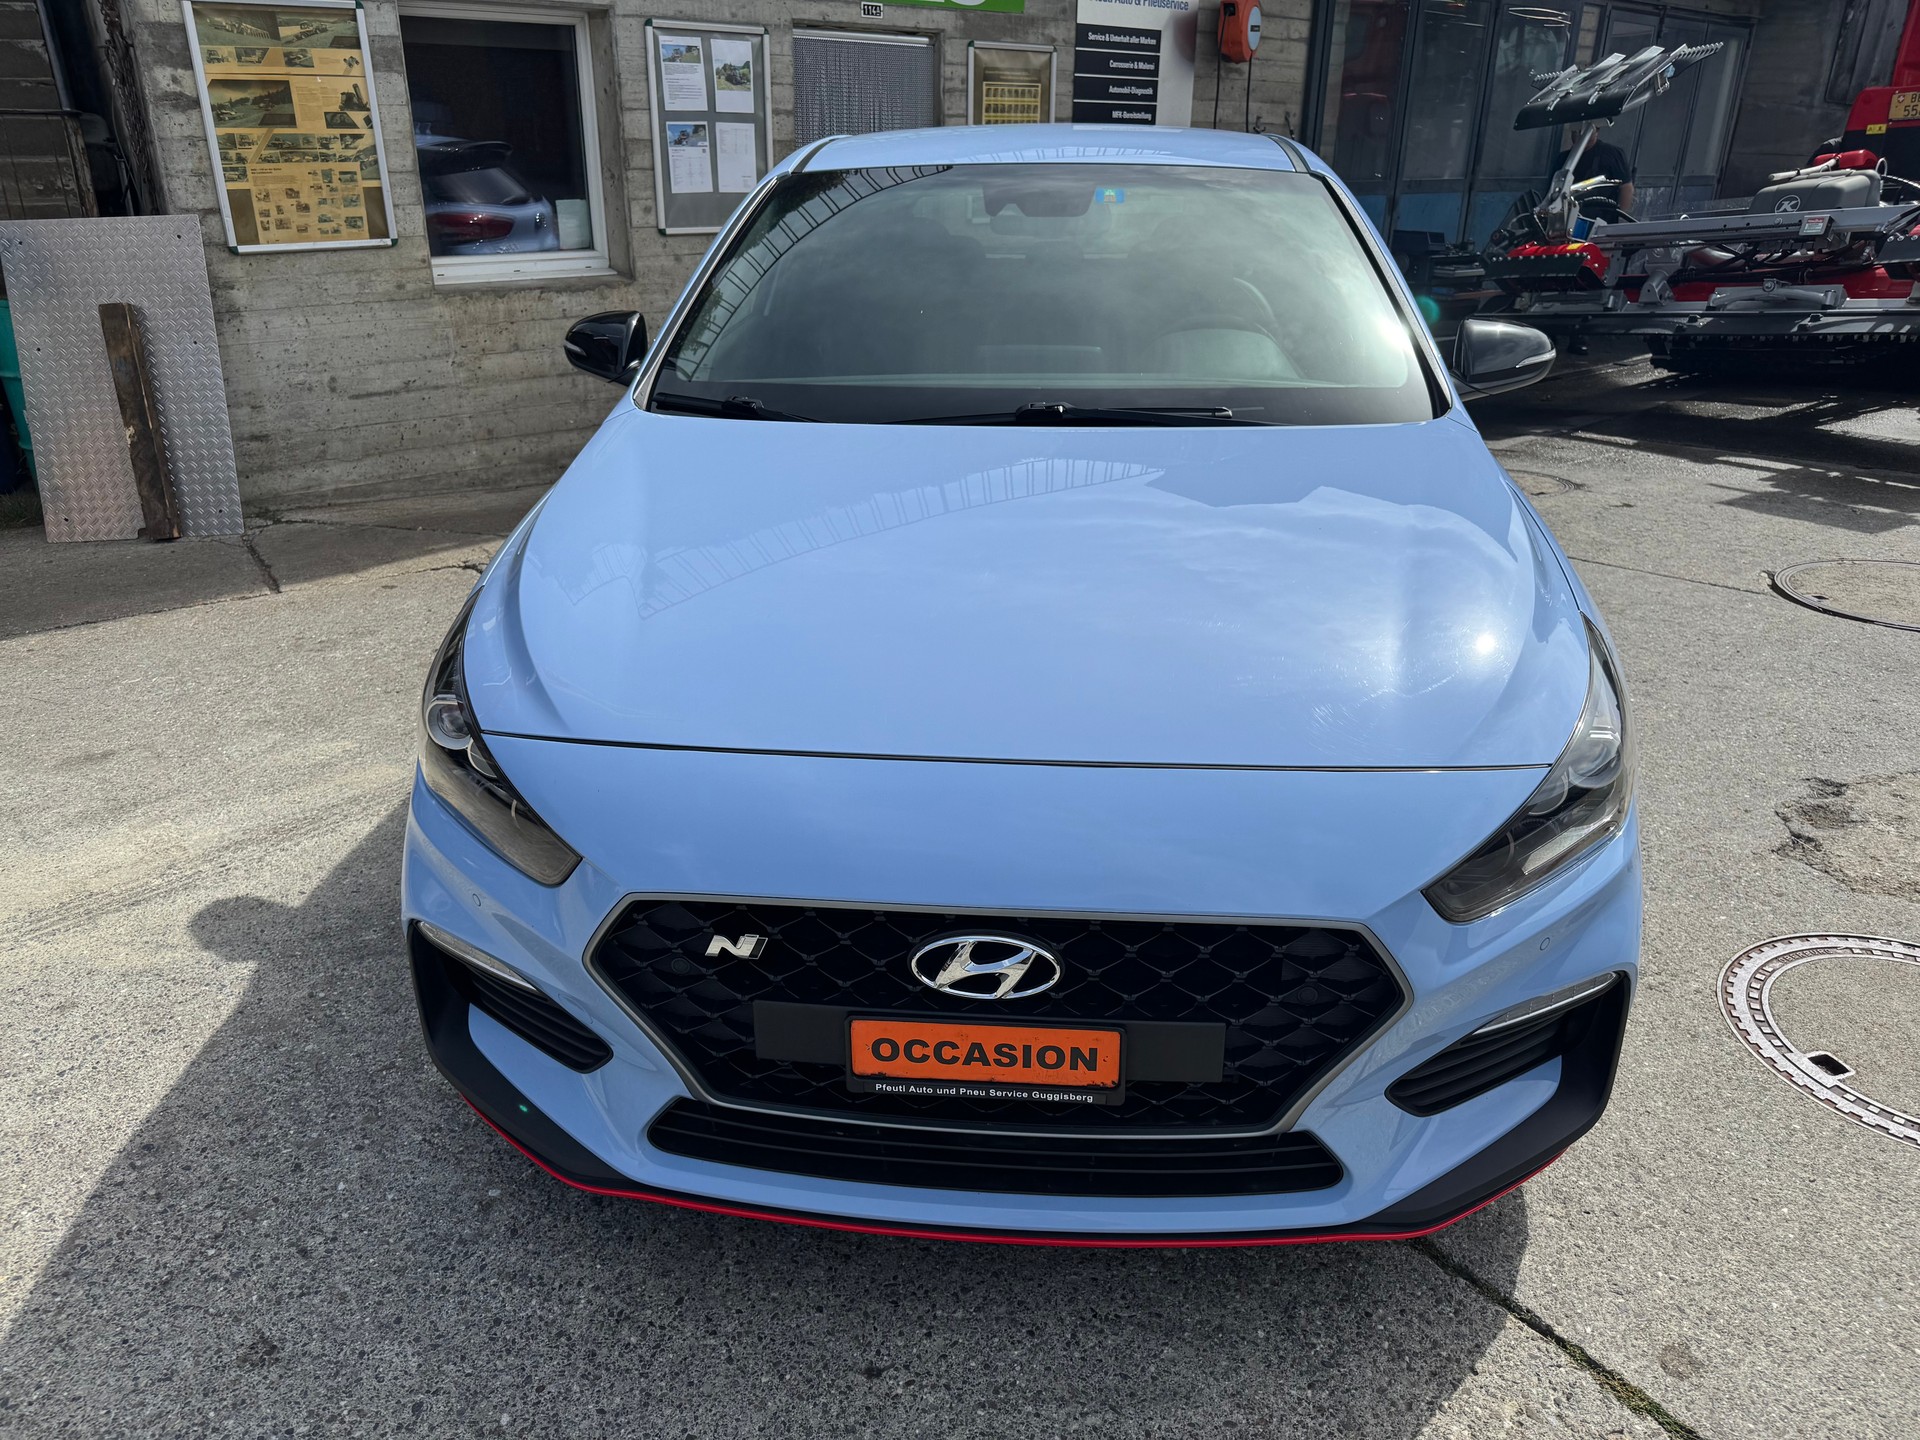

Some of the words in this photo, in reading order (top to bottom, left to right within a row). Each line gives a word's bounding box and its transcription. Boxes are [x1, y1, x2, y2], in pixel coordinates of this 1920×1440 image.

[1088, 32, 1105, 42] Service
[1105, 33, 1110, 42] &
[1110, 33, 1130, 44] Unterhalt
[1130, 35, 1140, 44] aller
[1140, 36, 1157, 45] Marken
[1108, 85, 1153, 95] Automobil-Diagnostik
[1903, 104, 1920, 117] 55
[871, 1037, 1098, 1072] OCCASION
[875, 1083, 906, 1092] Pfeuti
[909, 1085, 933, 1094] Auto
[936, 1087, 956, 1095] und
[959, 1088, 986, 1096] Pneu
[989, 1089, 1029, 1098] Service
[1032, 1091, 1093, 1103] Guggisberg
